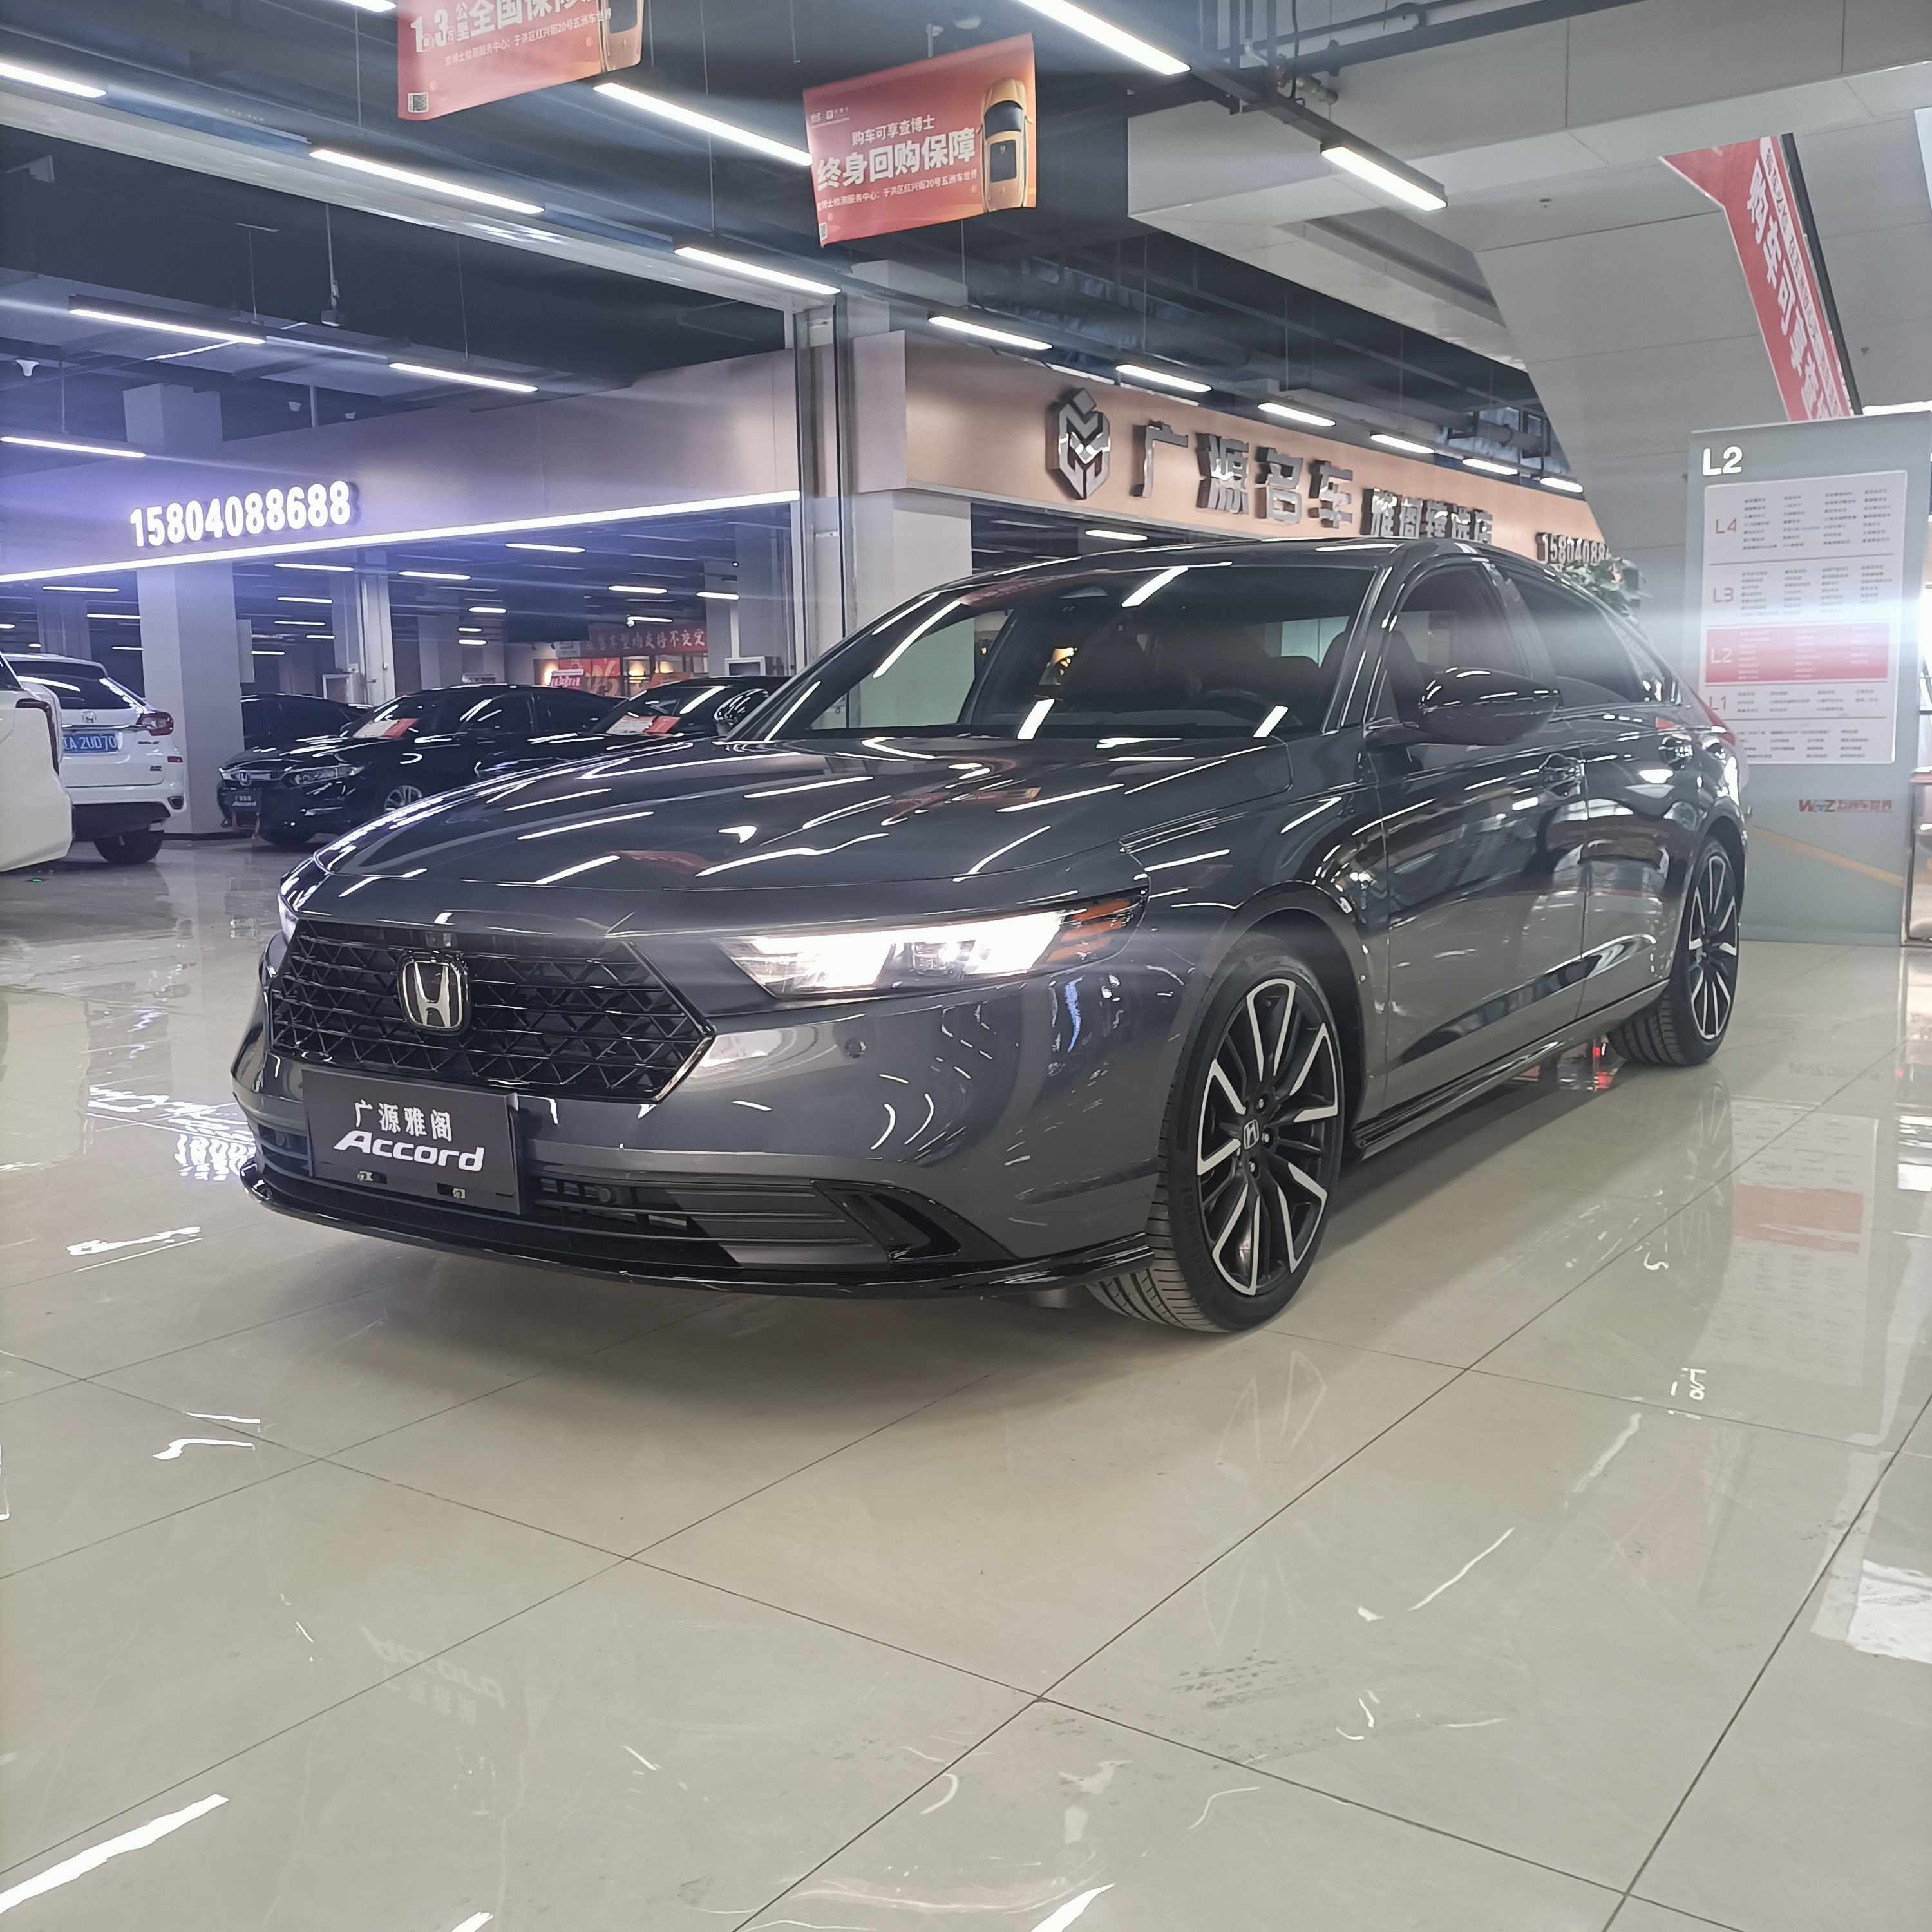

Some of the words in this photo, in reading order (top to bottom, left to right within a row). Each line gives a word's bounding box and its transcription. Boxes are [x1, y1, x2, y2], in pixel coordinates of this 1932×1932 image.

[851, 115, 935, 147] 购车可享查博士
[817, 127, 976, 191] 终身回购保障
[1139, 419, 1353, 529] 广源名车
[1703, 446, 1743, 476] L2
[130, 480, 351, 547] 15804088688
[1716, 518, 1738, 534] L4
[1713, 587, 1734, 603] L3
[1710, 648, 1733, 663] L2
[1709, 696, 1727, 710] L1
[354, 1099, 453, 1142] 广源雅阁
[333, 1130, 485, 1172] Accord
